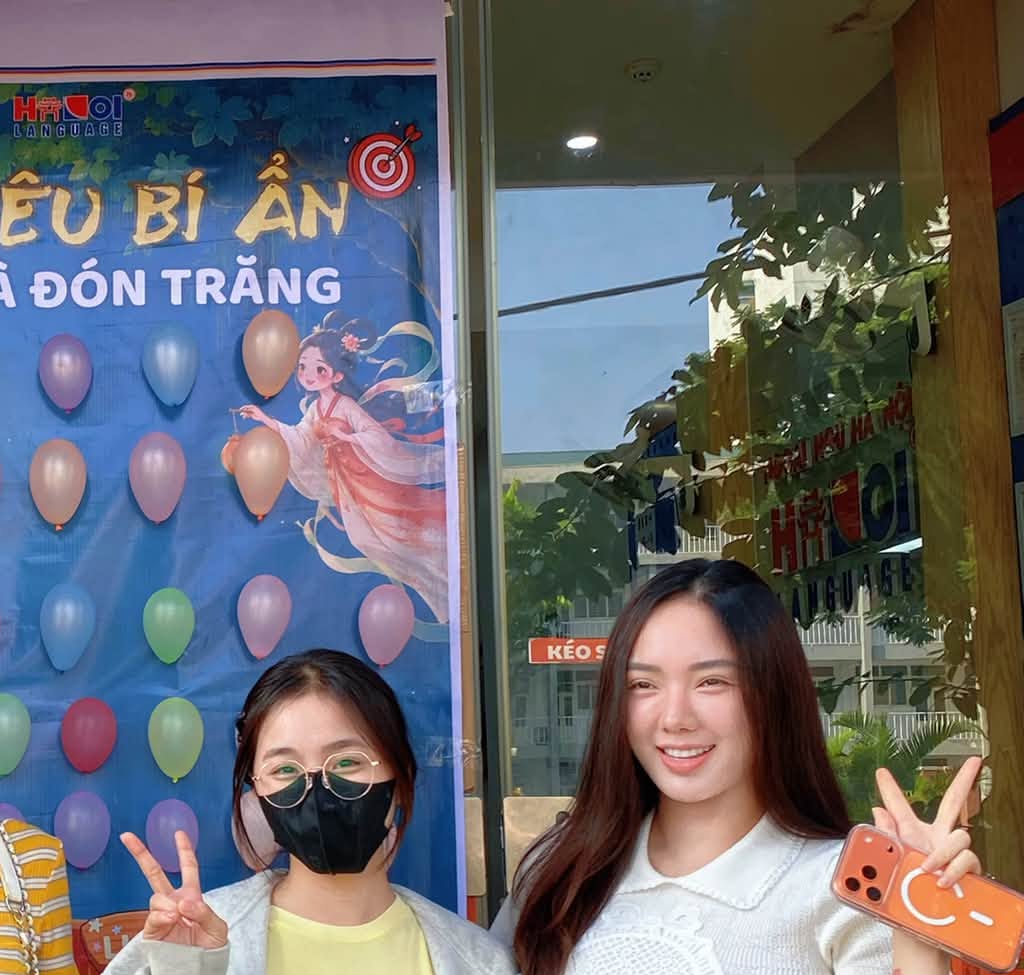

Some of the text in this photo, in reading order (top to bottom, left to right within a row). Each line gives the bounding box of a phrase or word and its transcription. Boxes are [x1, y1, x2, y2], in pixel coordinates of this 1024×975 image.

[12, 95, 124, 121] HANOI
[13, 121, 123, 137] LANGUAGE
[132, 168, 207, 245] BÍ
[233, 151, 350, 244] ẨN
[29, 257, 146, 307] ĐÓN
[161, 254, 342, 305] TRĂNG
[547, 639, 591, 660] KÉO
